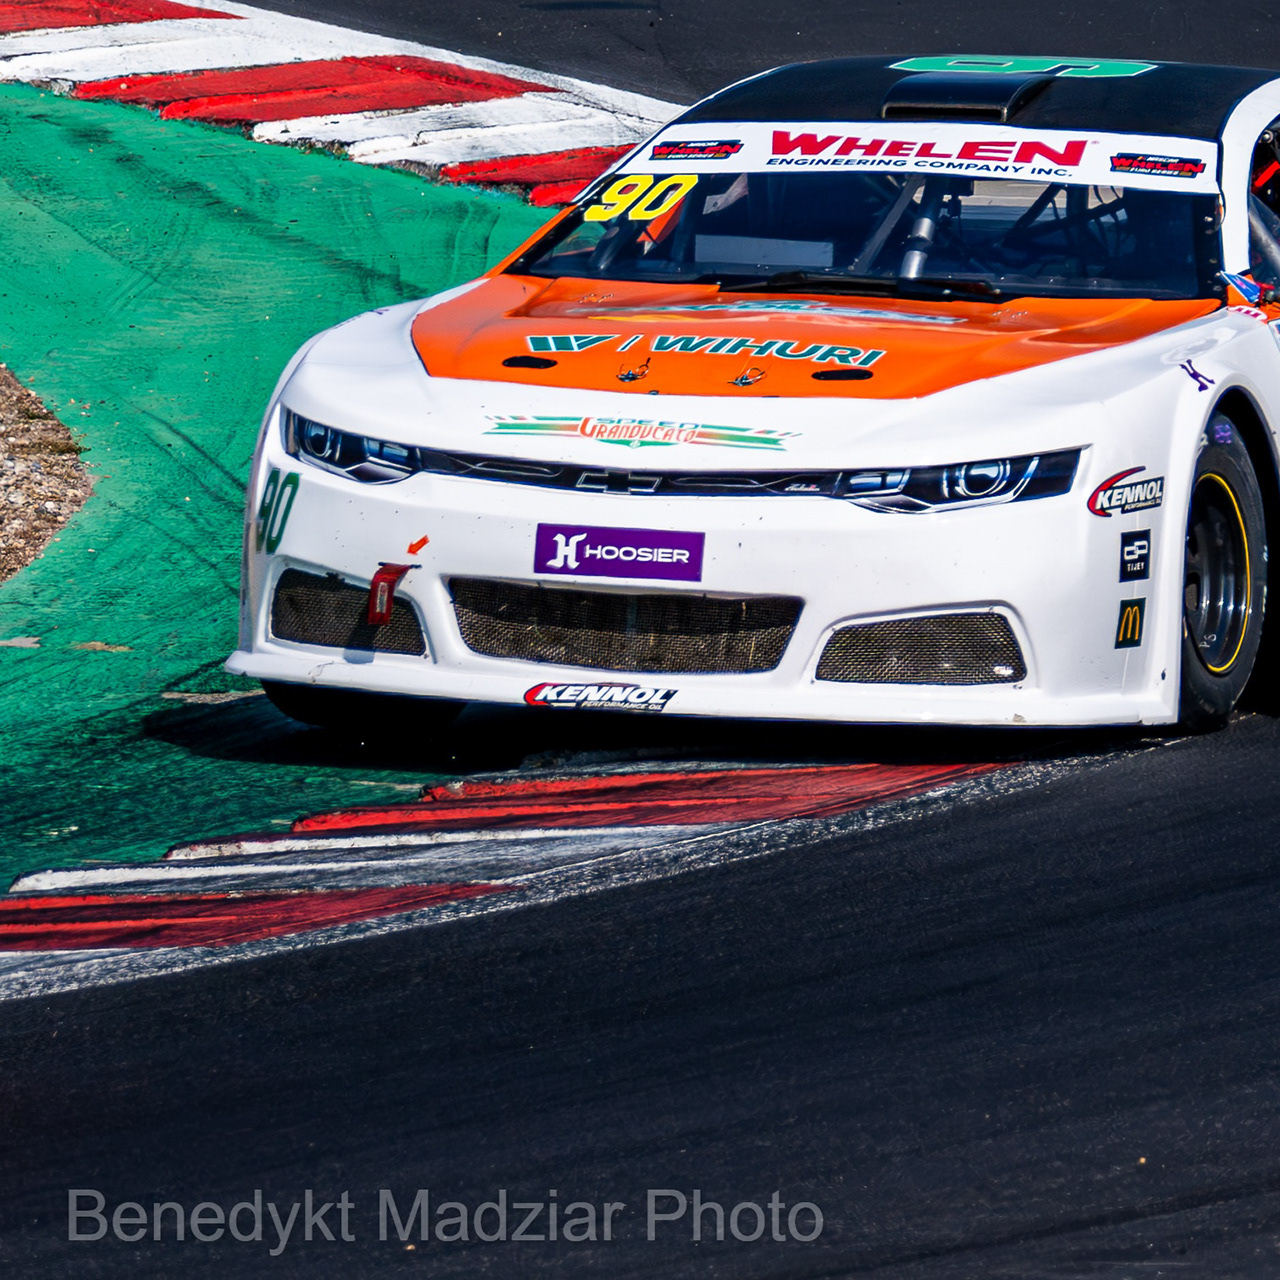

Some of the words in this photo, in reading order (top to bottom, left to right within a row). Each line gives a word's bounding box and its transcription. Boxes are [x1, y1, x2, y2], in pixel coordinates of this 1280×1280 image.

[771, 130, 1088, 167] WHELEN
[766, 158, 907, 168] ENGINEERING
[914, 160, 1025, 174] COMPANY
[1030, 167, 1073, 178] INC.
[584, 174, 698, 221] 90
[652, 335, 886, 368] WIHURI
[1095, 479, 1163, 511] KENNOL
[583, 542, 690, 565] HOOSIER
[534, 685, 671, 704] KENNOL
